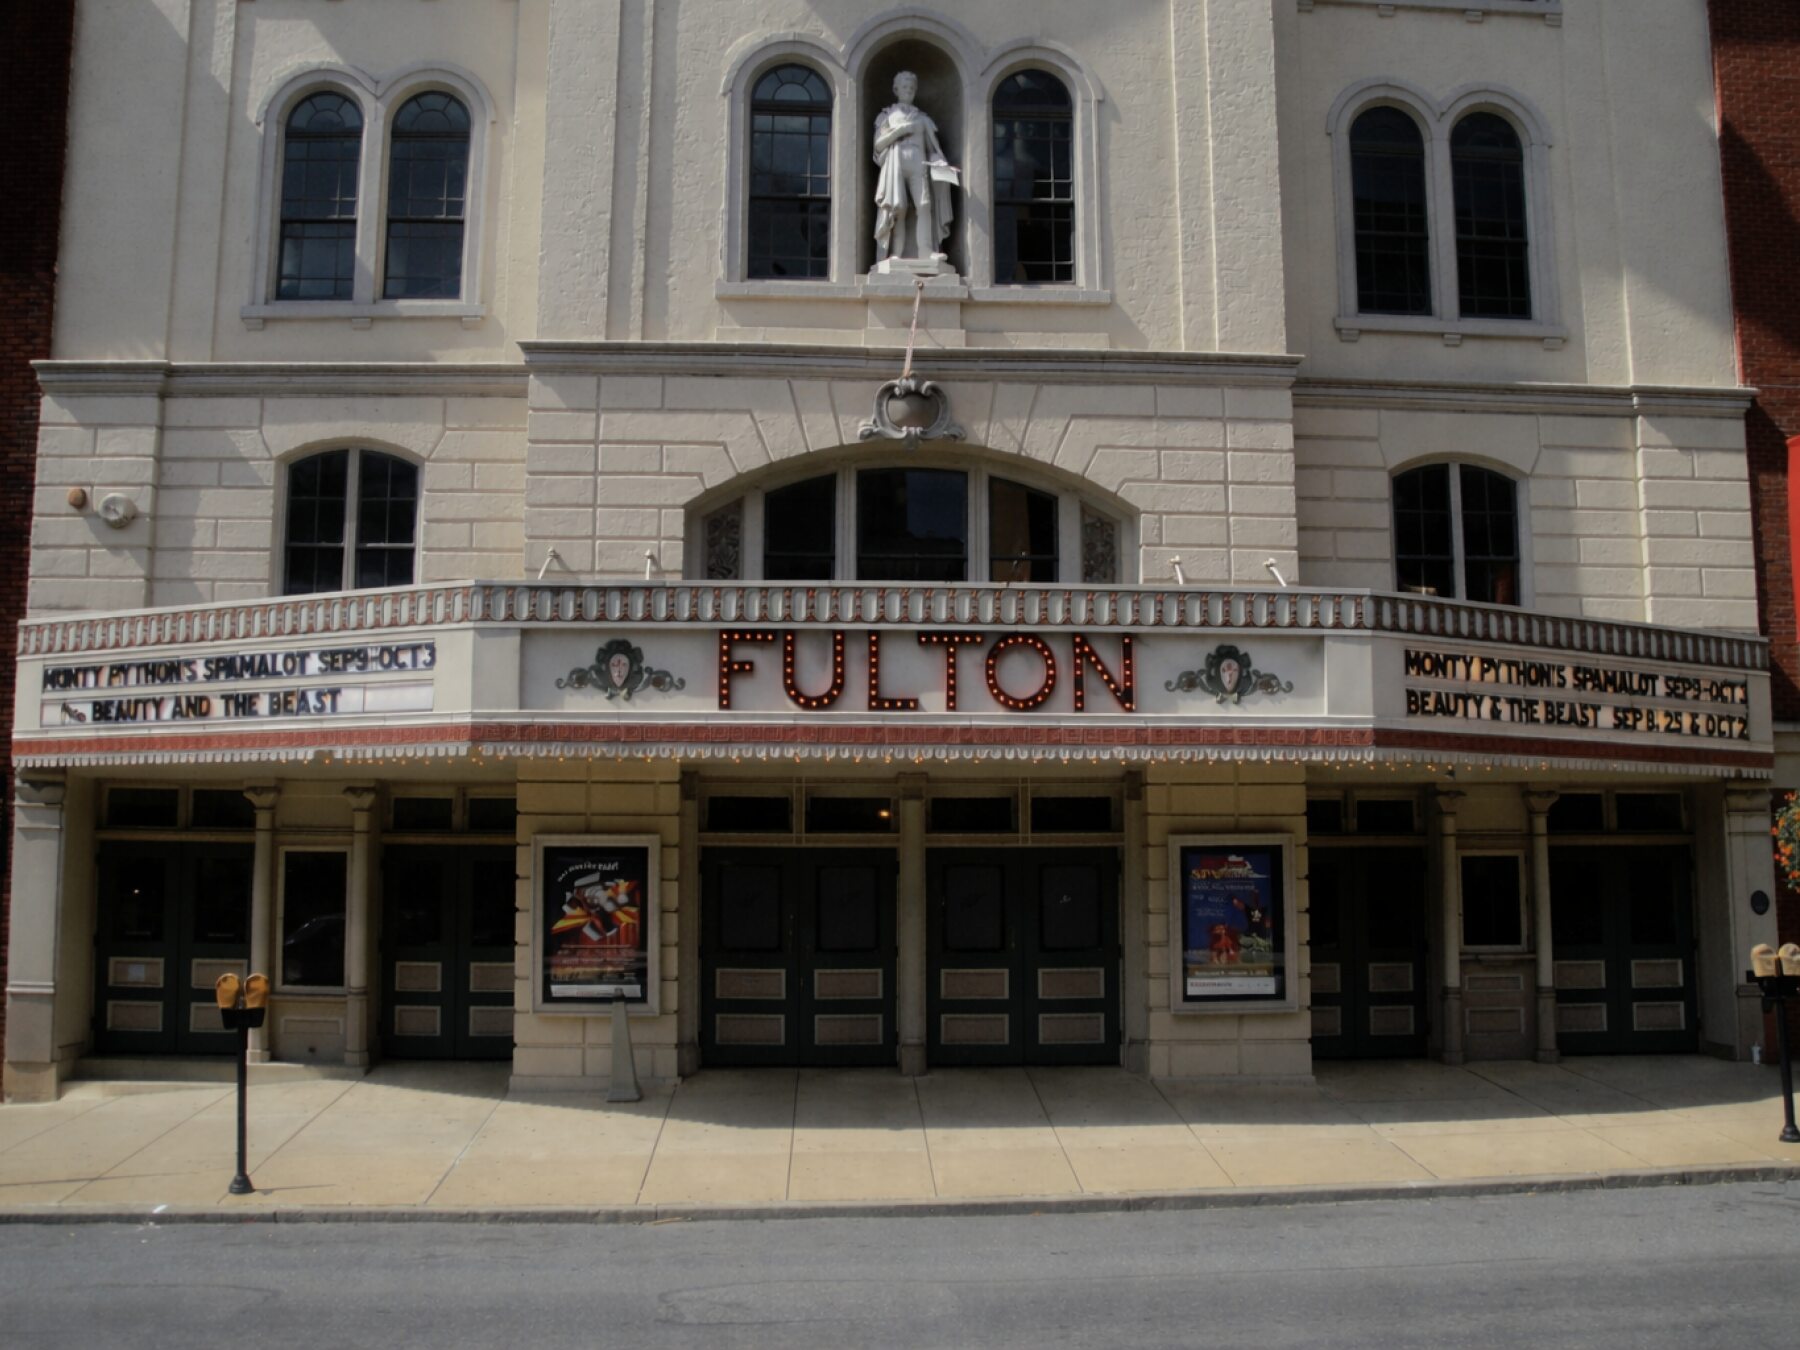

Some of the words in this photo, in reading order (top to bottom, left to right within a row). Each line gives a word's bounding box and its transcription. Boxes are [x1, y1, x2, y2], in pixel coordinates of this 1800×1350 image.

[44, 665, 104, 689] MONTY
[109, 659, 198, 687] PYTHON'S
[203, 651, 310, 680] SPAMALOT
[719, 630, 1137, 711] FULTON
[1405, 649, 1474, 681] MONTY
[1480, 657, 1566, 689] PYTHON'S
[1573, 666, 1659, 697] SPAMALOT
[92, 696, 164, 722] BEAUTY
[172, 695, 211, 719] AND
[220, 692, 259, 717] THE
[269, 688, 341, 716] BEAST
[1406, 688, 1484, 718] BEAUTY
[1490, 694, 1502, 720] &
[1505, 697, 1540, 723] THE
[1545, 700, 1601, 727] BEAST
